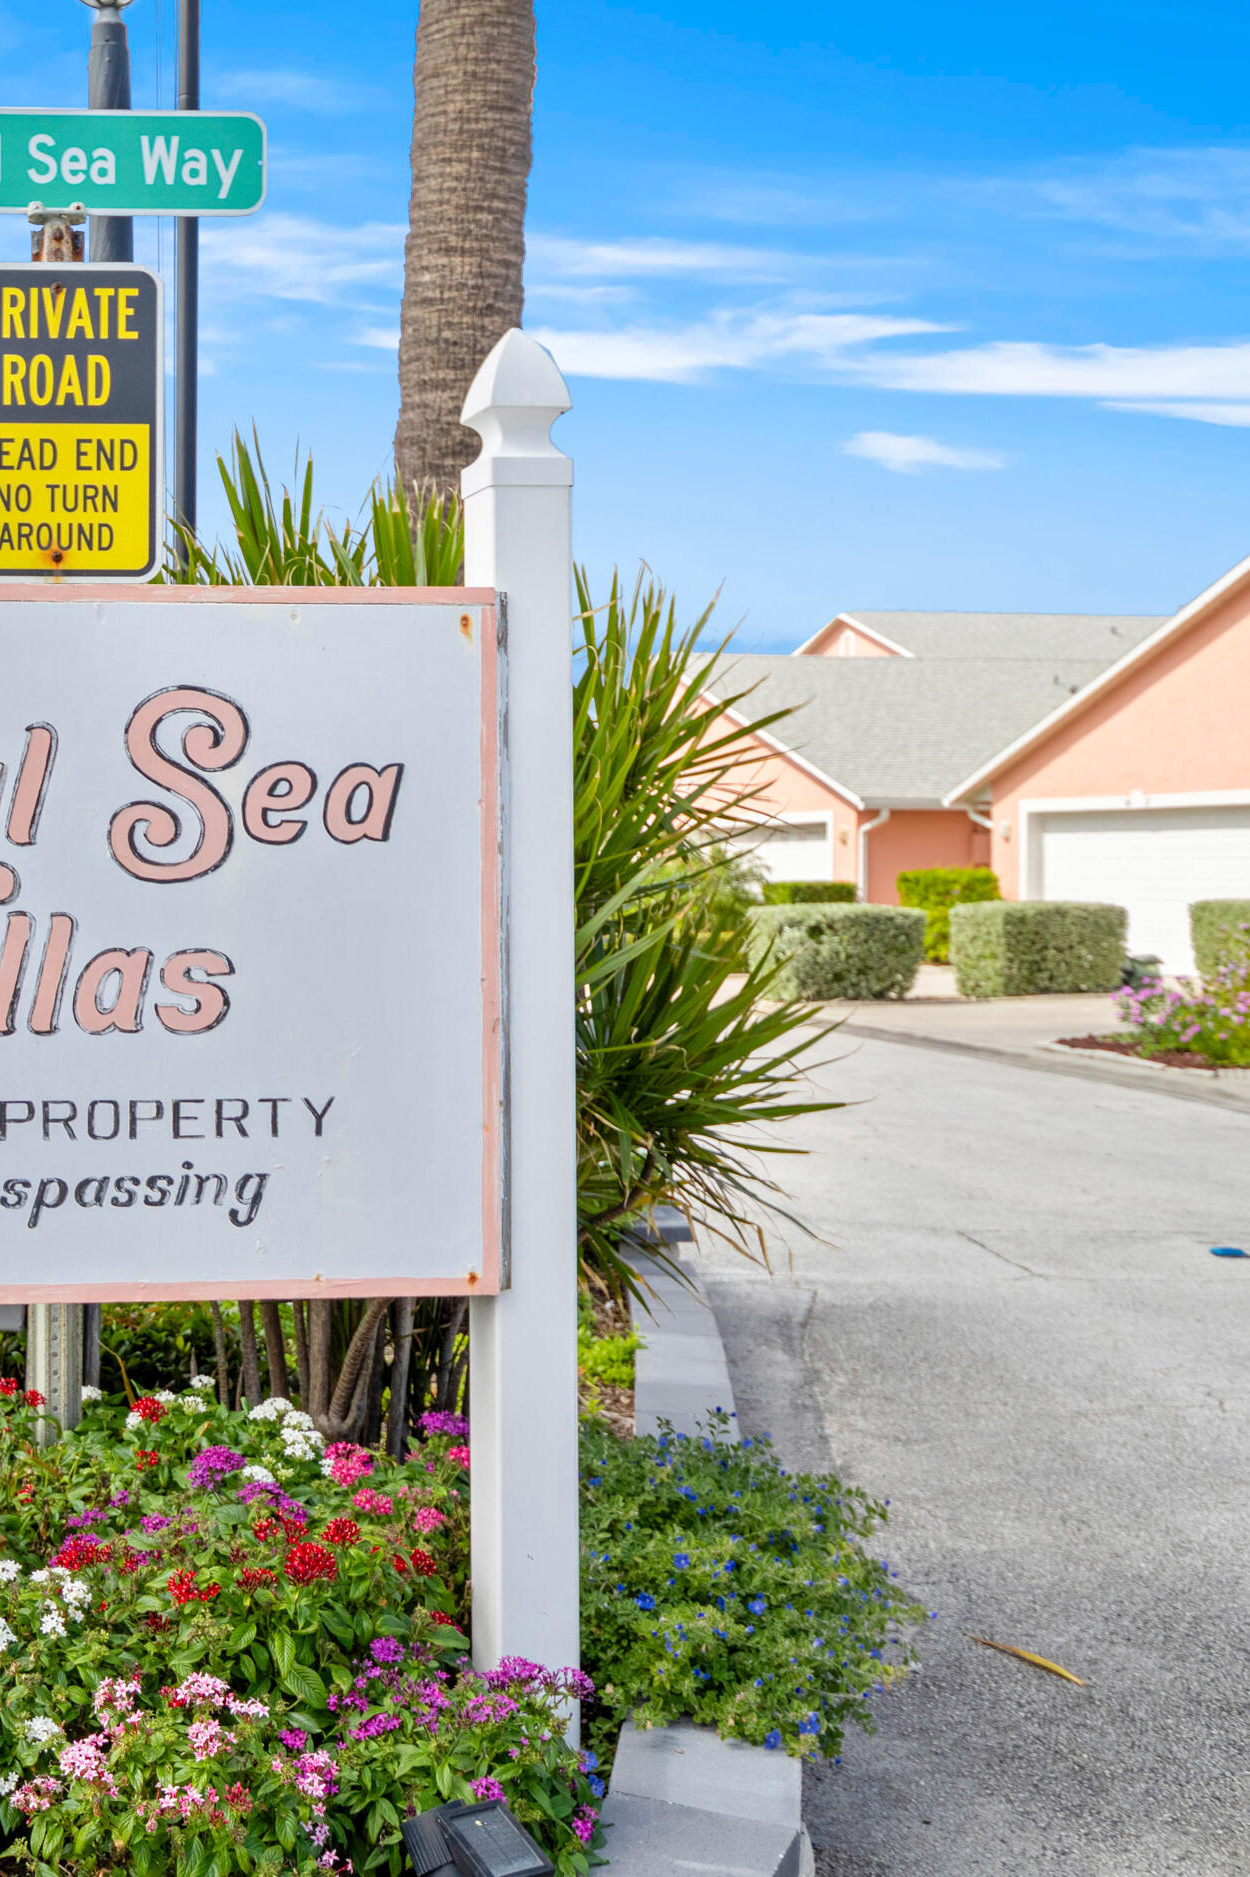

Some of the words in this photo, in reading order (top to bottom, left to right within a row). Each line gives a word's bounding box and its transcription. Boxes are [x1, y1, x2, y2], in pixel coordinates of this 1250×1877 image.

[27, 134, 116, 185] Sea
[140, 135, 243, 199] Way
[2, 354, 112, 406] ROAD
[75, 438, 138, 471] END
[46, 484, 119, 513] TURN
[107, 684, 405, 884] Sea
